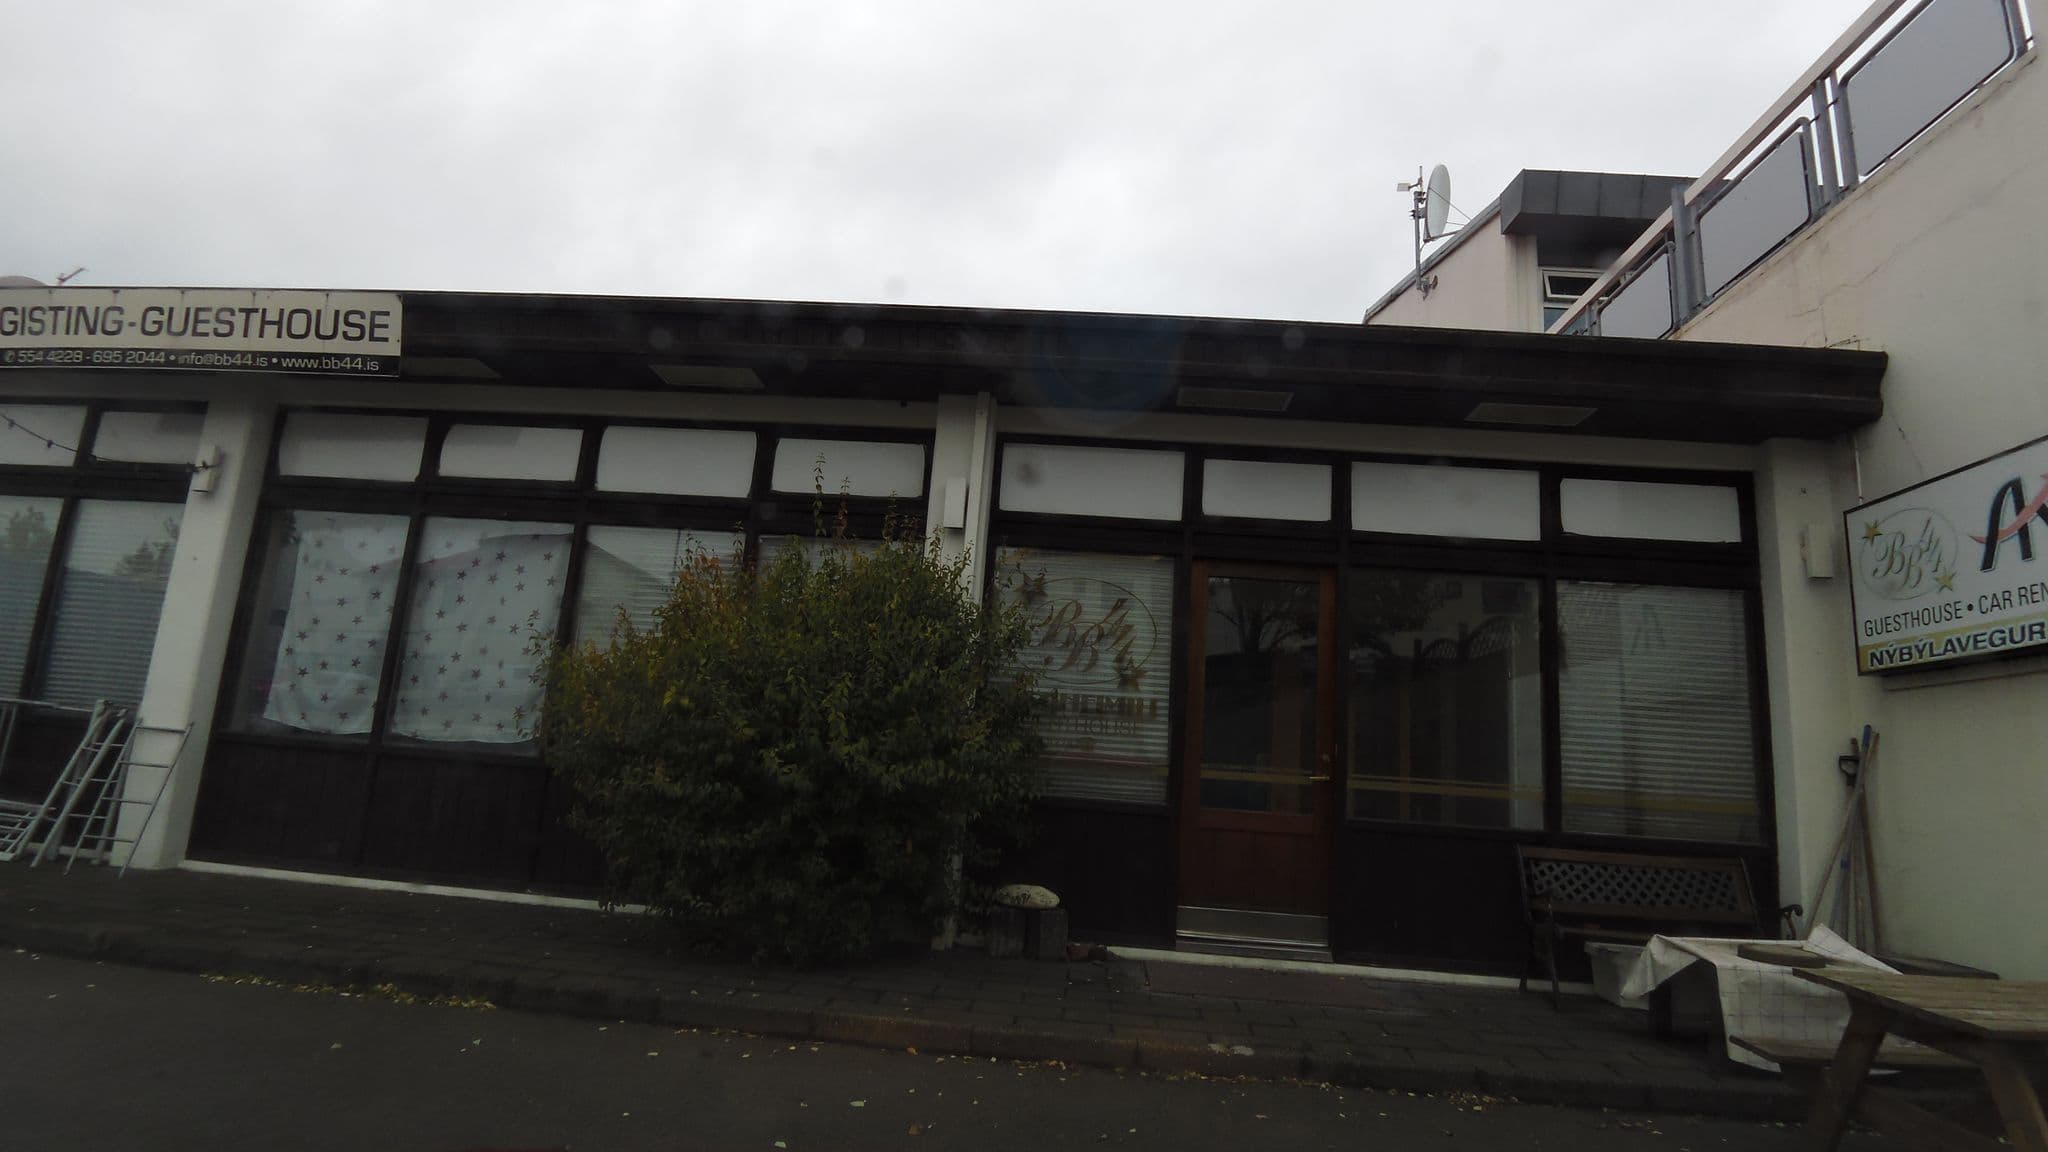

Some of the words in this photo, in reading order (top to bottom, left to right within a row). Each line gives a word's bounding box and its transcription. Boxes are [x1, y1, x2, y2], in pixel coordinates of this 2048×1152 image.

[17, 350, 44, 363] 554
[92, 350, 123, 364] 695
[125, 350, 166, 364] 2044
[177, 351, 268, 367] info@bb44.is
[281, 356, 380, 371] www.bb44.is
[1863, 600, 1963, 637] GUESTHOUSE
[1978, 589, 2013, 615] CAR
[1869, 620, 2048, 668] NÝBÝLAVEGUR
